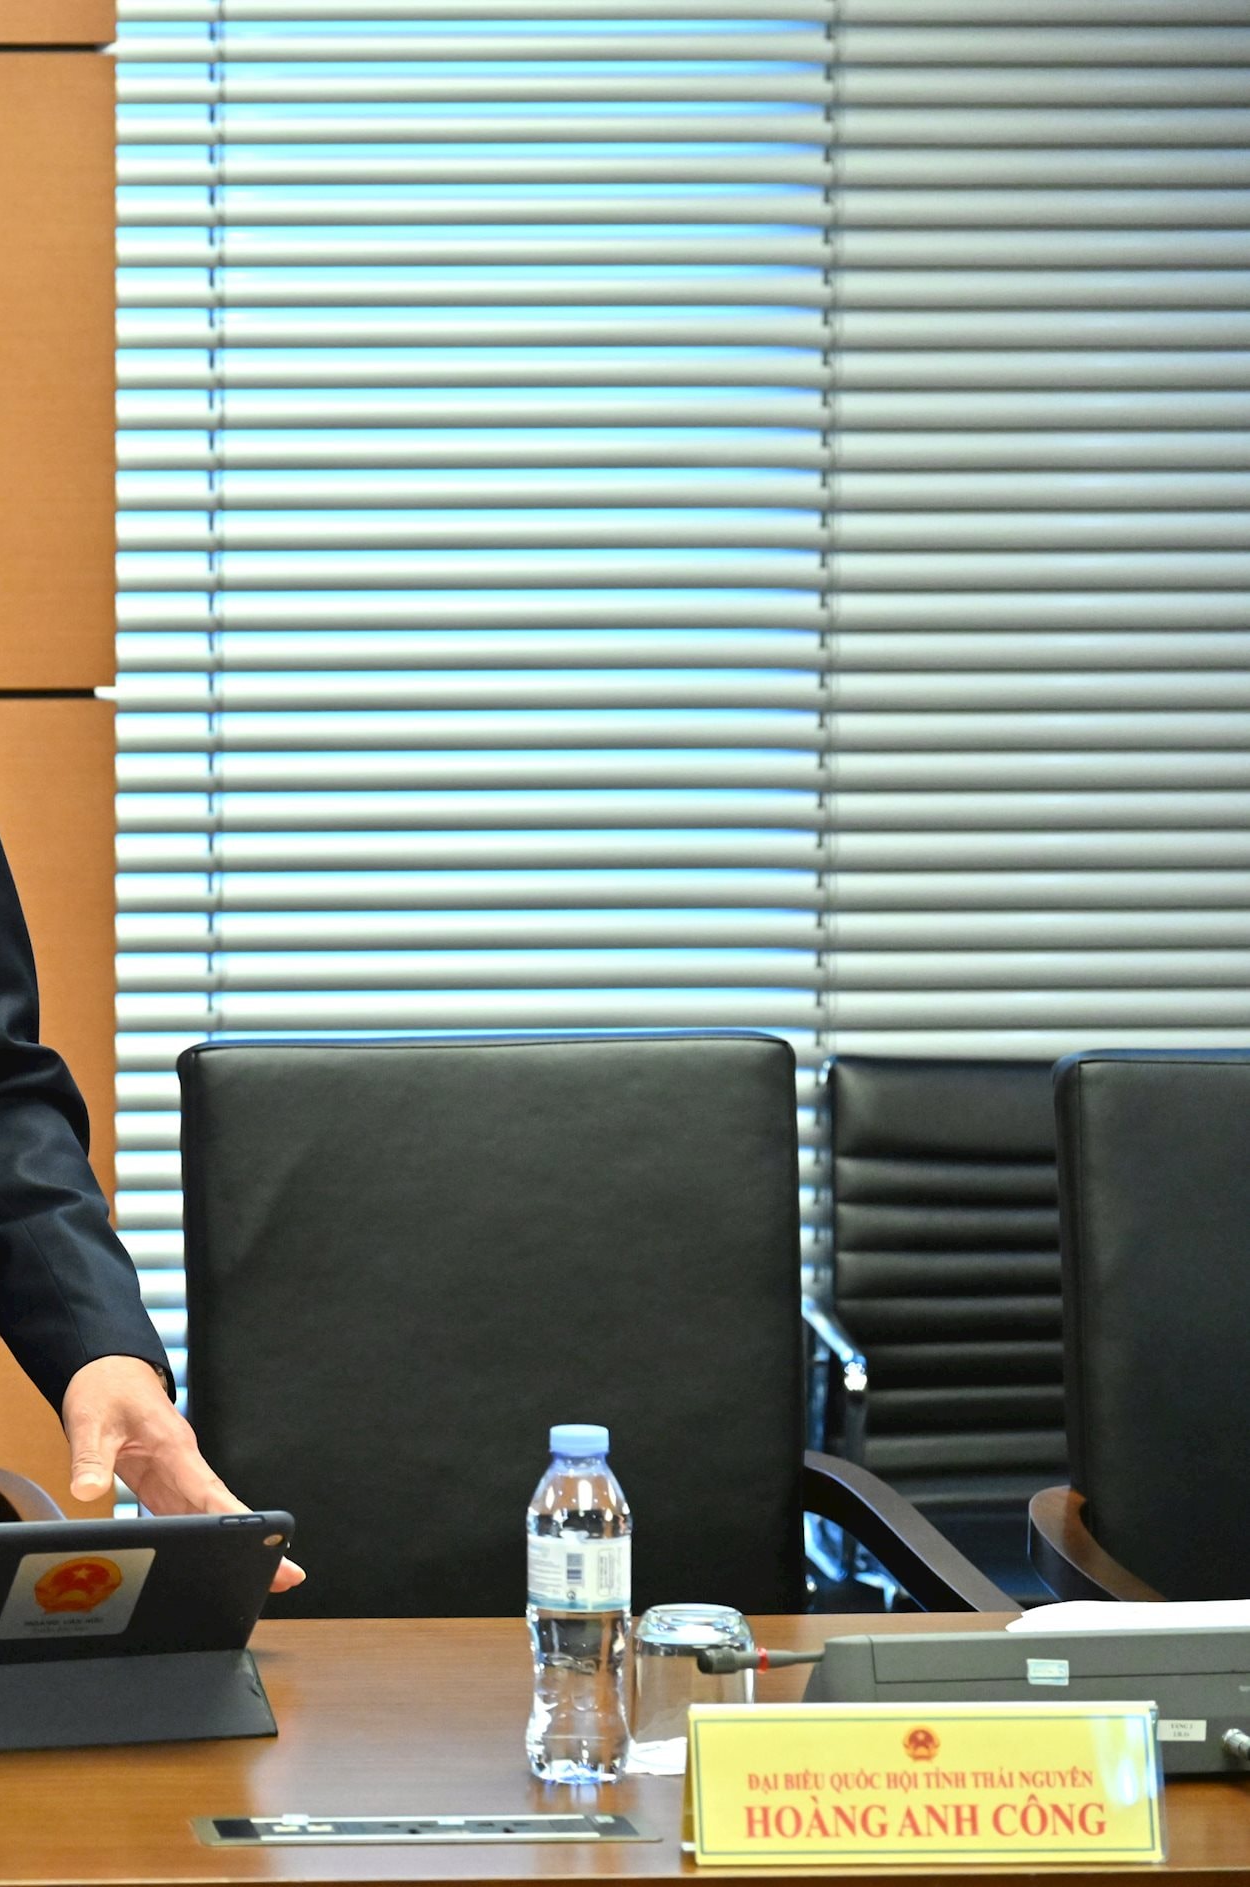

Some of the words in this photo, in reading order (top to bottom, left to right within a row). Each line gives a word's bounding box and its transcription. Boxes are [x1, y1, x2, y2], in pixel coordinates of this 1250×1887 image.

[747, 1773, 779, 1795] ĐẠI
[886, 1770, 919, 1794] HỘI
[1019, 1765, 1094, 1789] NGUYÊN
[744, 1795, 889, 1838] HOÀNG
[897, 1803, 980, 1838] ANH
[991, 1793, 1107, 1837] CÔNG
